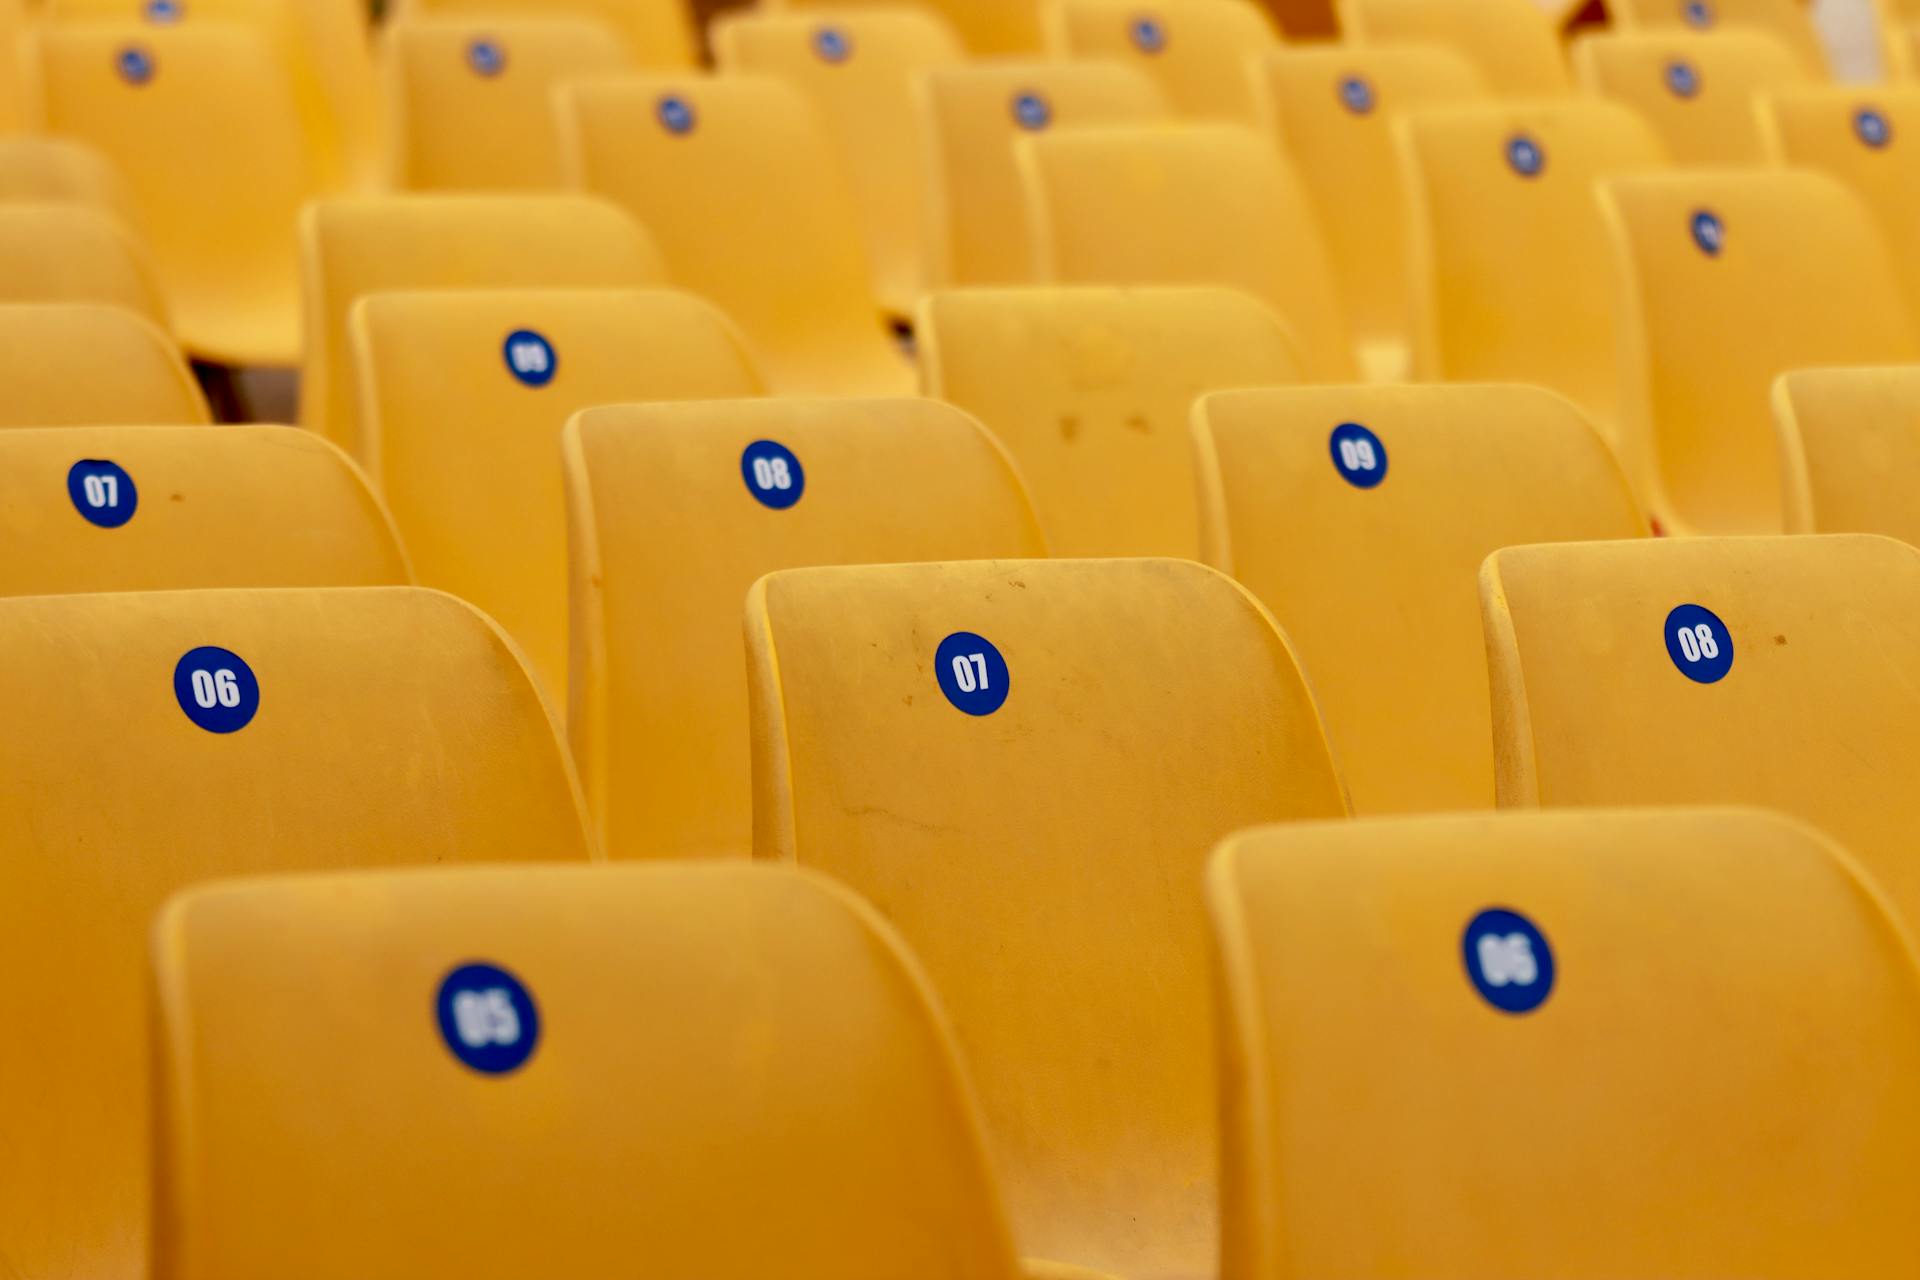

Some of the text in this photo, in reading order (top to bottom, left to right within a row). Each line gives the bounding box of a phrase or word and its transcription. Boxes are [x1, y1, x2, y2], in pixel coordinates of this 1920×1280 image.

[1340, 439, 1376, 470] 09
[83, 475, 118, 508] 07
[753, 457, 791, 490] 08
[1677, 623, 1719, 663] 08
[191, 668, 241, 709] 06
[952, 653, 989, 693] 07
